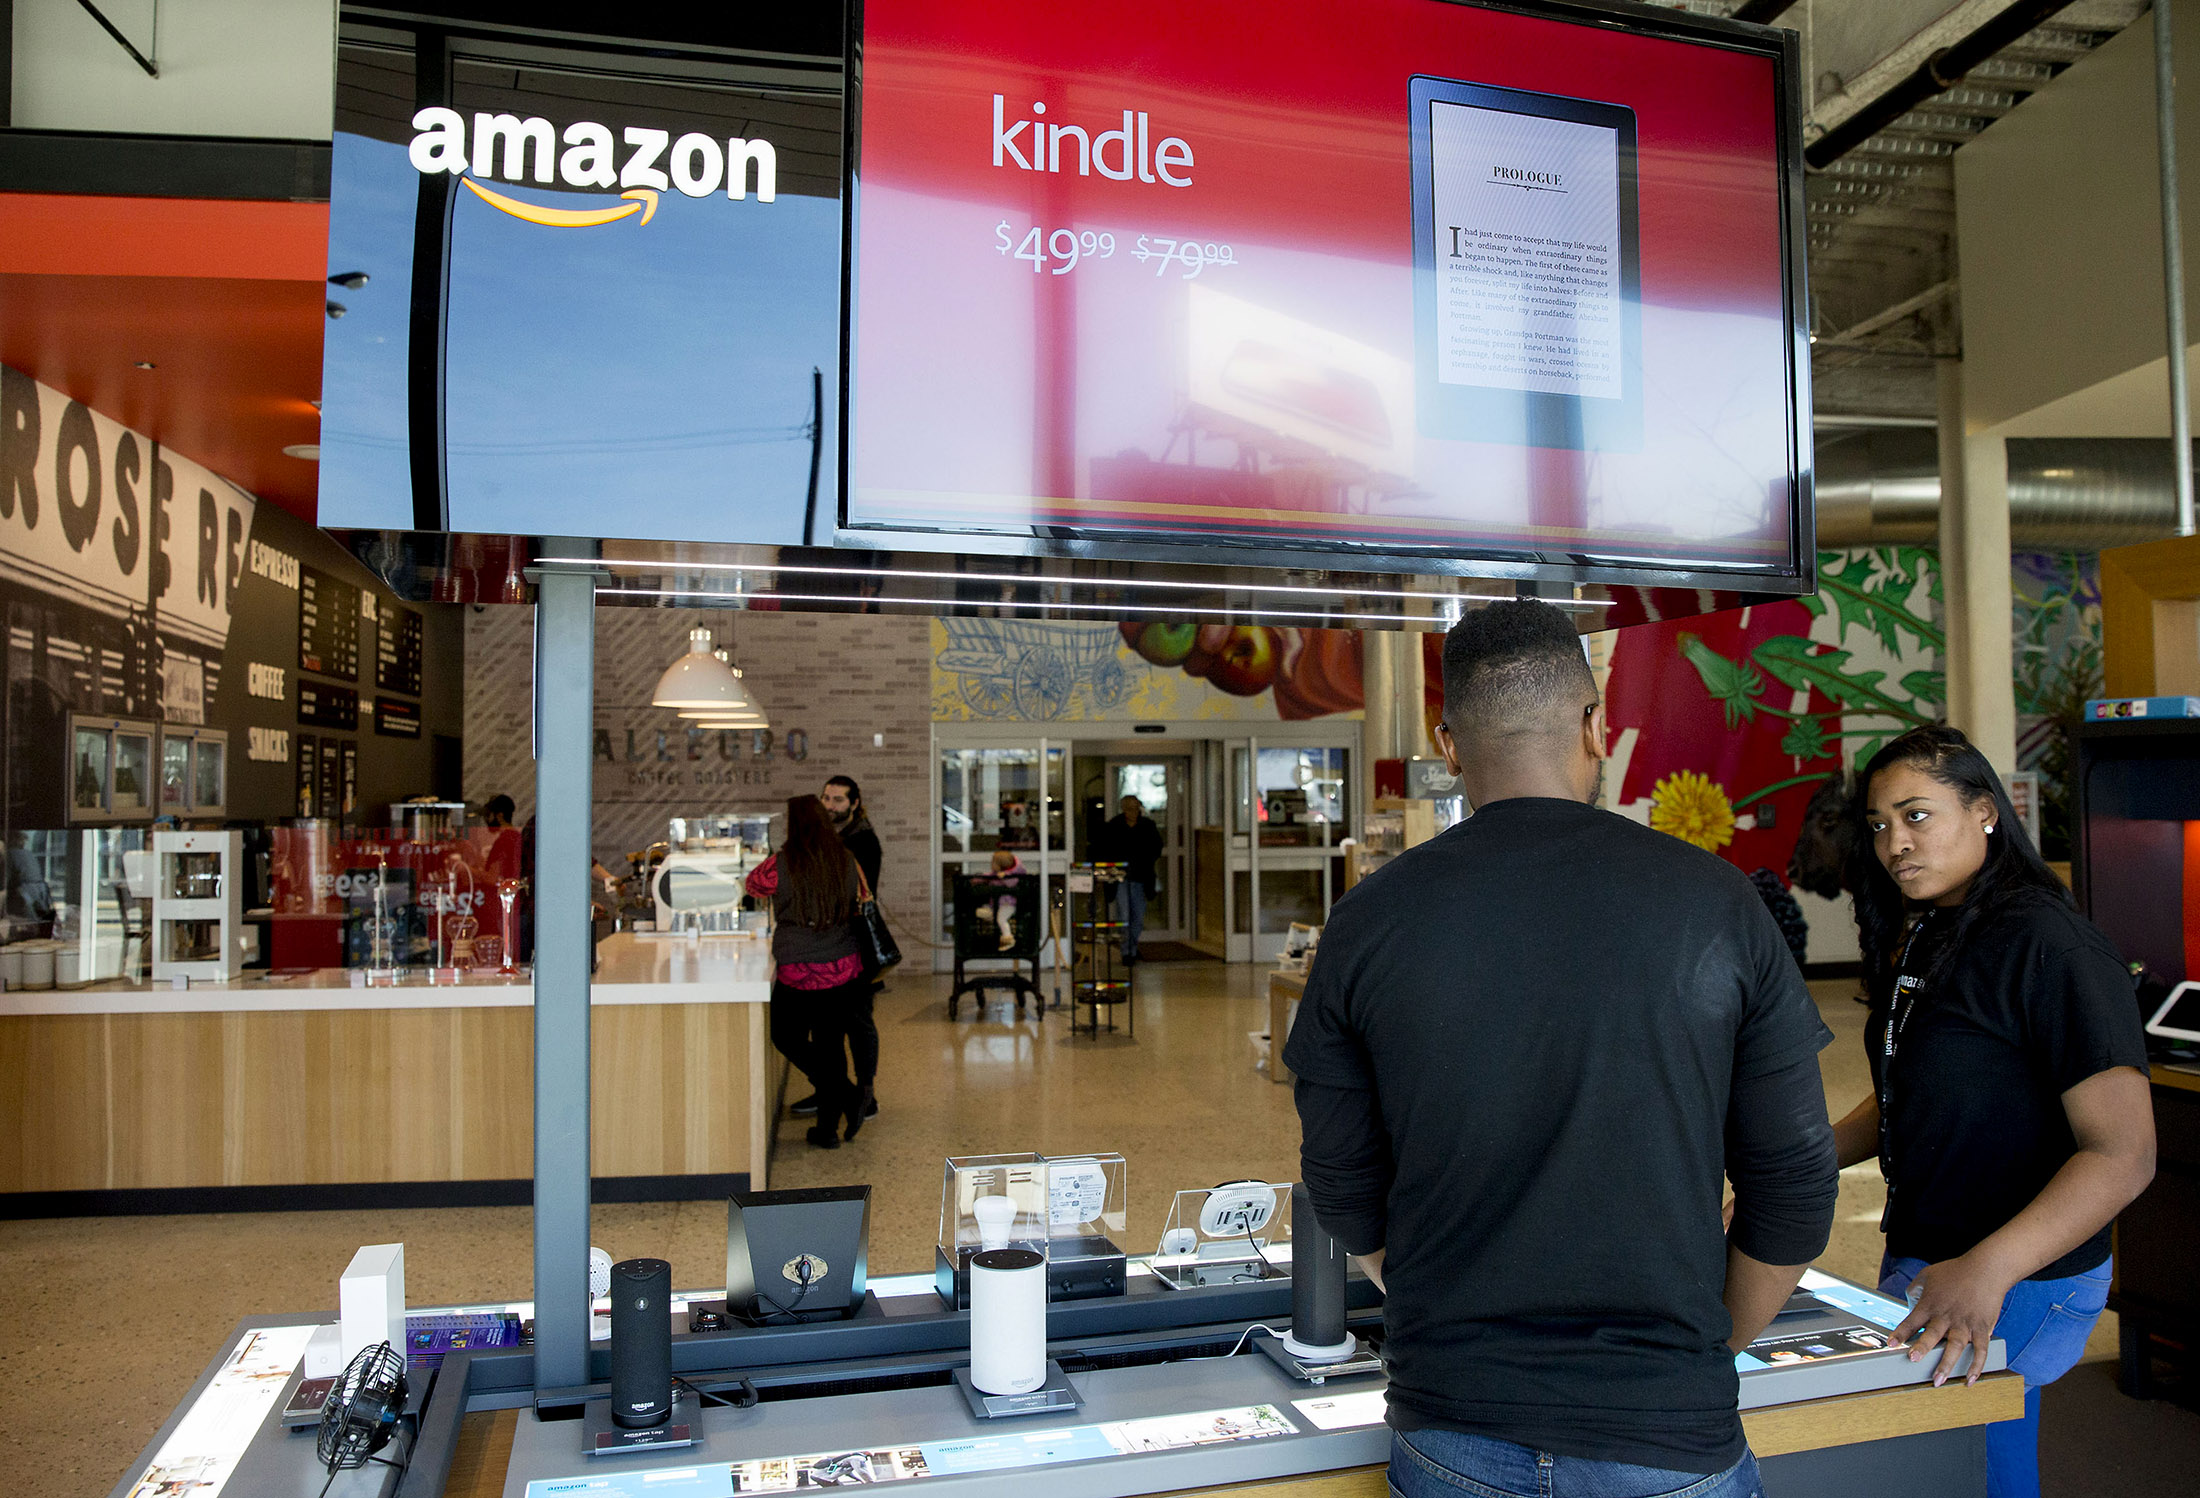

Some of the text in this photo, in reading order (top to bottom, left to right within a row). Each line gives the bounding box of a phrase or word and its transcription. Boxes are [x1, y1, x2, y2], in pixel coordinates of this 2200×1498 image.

[408, 106, 777, 203] amazon
[993, 93, 1194, 187] kindle
[1492, 165, 1562, 186] PROLOGUE
[1449, 226, 1462, 258] I
[1479, 230, 1492, 238] just
[1523, 236, 1544, 245] accept
[1546, 238, 1560, 246] that
[1574, 241, 1585, 249] life
[1587, 244, 1607, 252] would
[1478, 241, 1508, 253] ordinary
[1512, 246, 1531, 255] when
[1536, 250, 1582, 262] extraordinary
[1586, 255, 1607, 265] things
[1455, 264, 1481, 272] terrible
[1483, 266, 1503, 275] shock
[1521, 271, 1533, 279] like
[1534, 274, 1565, 284] anything
[1566, 276, 1580, 284] that
[1581, 278, 1608, 288] changes
[1465, 252, 1485, 261] began
[1496, 256, 1523, 266] happen.
[1525, 260, 1538, 268] The
[1539, 261, 1552, 269] first
[1563, 264, 1580, 272] these
[250, 539, 300, 590] ESPRESSO
[248, 662, 285, 700] COFFEE
[248, 726, 289, 763] SNACKS
[1885, 1020, 1894, 1056] amazon
[791, 1286, 818, 1294] amzon
[547, 1482, 587, 1492] amazon
